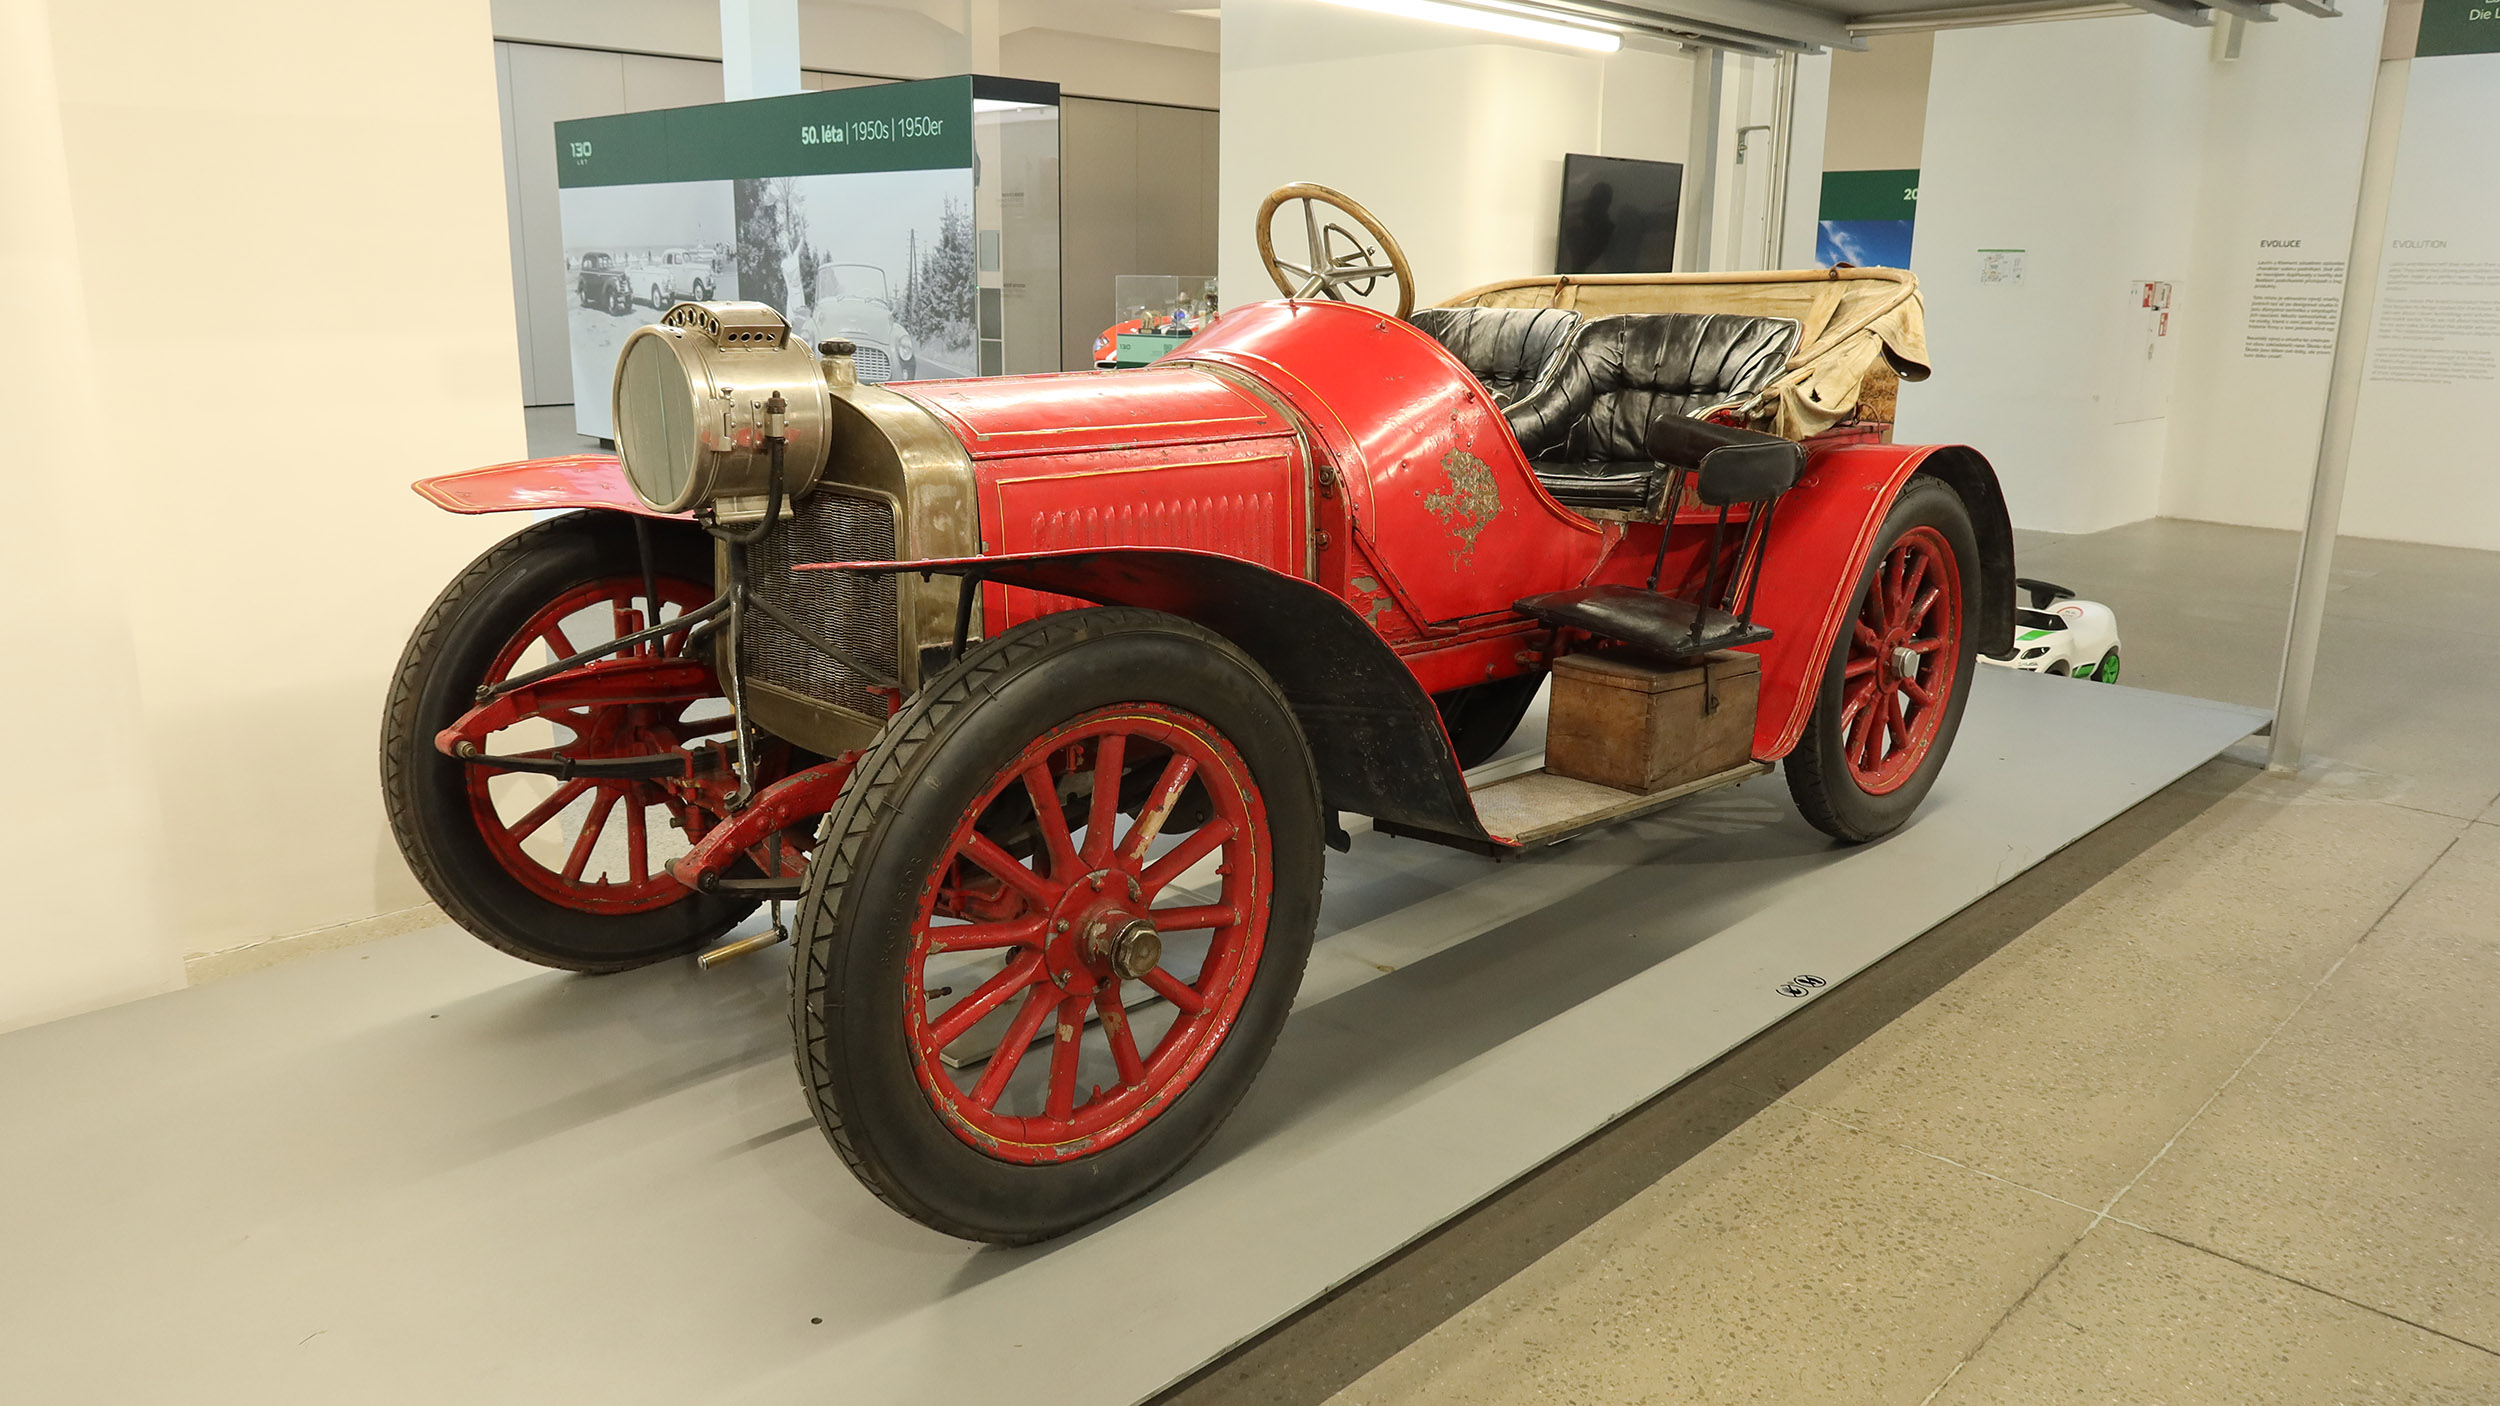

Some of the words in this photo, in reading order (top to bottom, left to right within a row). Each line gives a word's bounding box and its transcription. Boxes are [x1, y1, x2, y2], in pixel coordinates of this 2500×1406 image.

[2469, 9, 2492, 21] Die
[802, 126, 820, 145] 50.
[822, 125, 844, 144] léta
[852, 120, 890, 141] 1950s
[898, 116, 944, 138] 1950er
[570, 141, 592, 158] 130
[1903, 188, 1919, 200] 20
[2260, 239, 2302, 248] EVOLUCE
[2392, 239, 2448, 249] EVOLUTION
